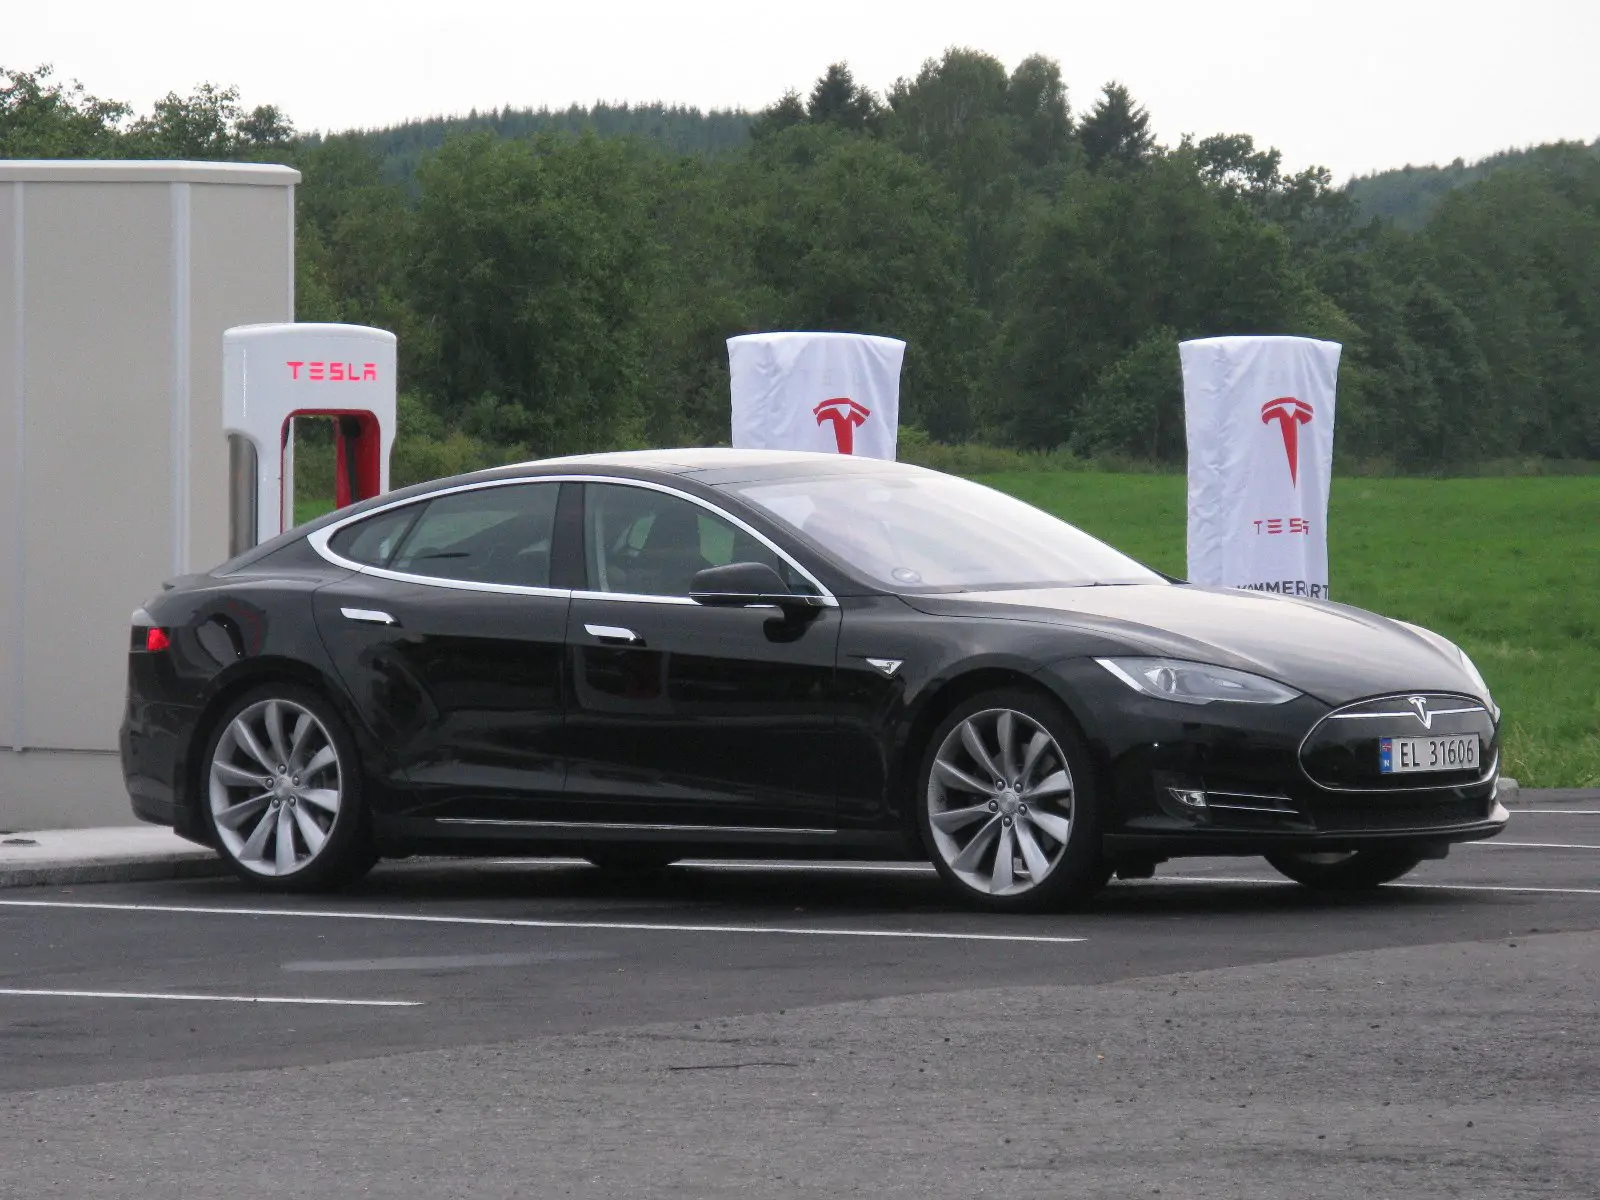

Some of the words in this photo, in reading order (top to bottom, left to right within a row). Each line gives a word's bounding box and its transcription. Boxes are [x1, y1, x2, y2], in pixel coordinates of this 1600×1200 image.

[286, 361, 377, 381] TESLA
[1400, 742, 1420, 768] EL
[1429, 739, 1474, 766] 31606
